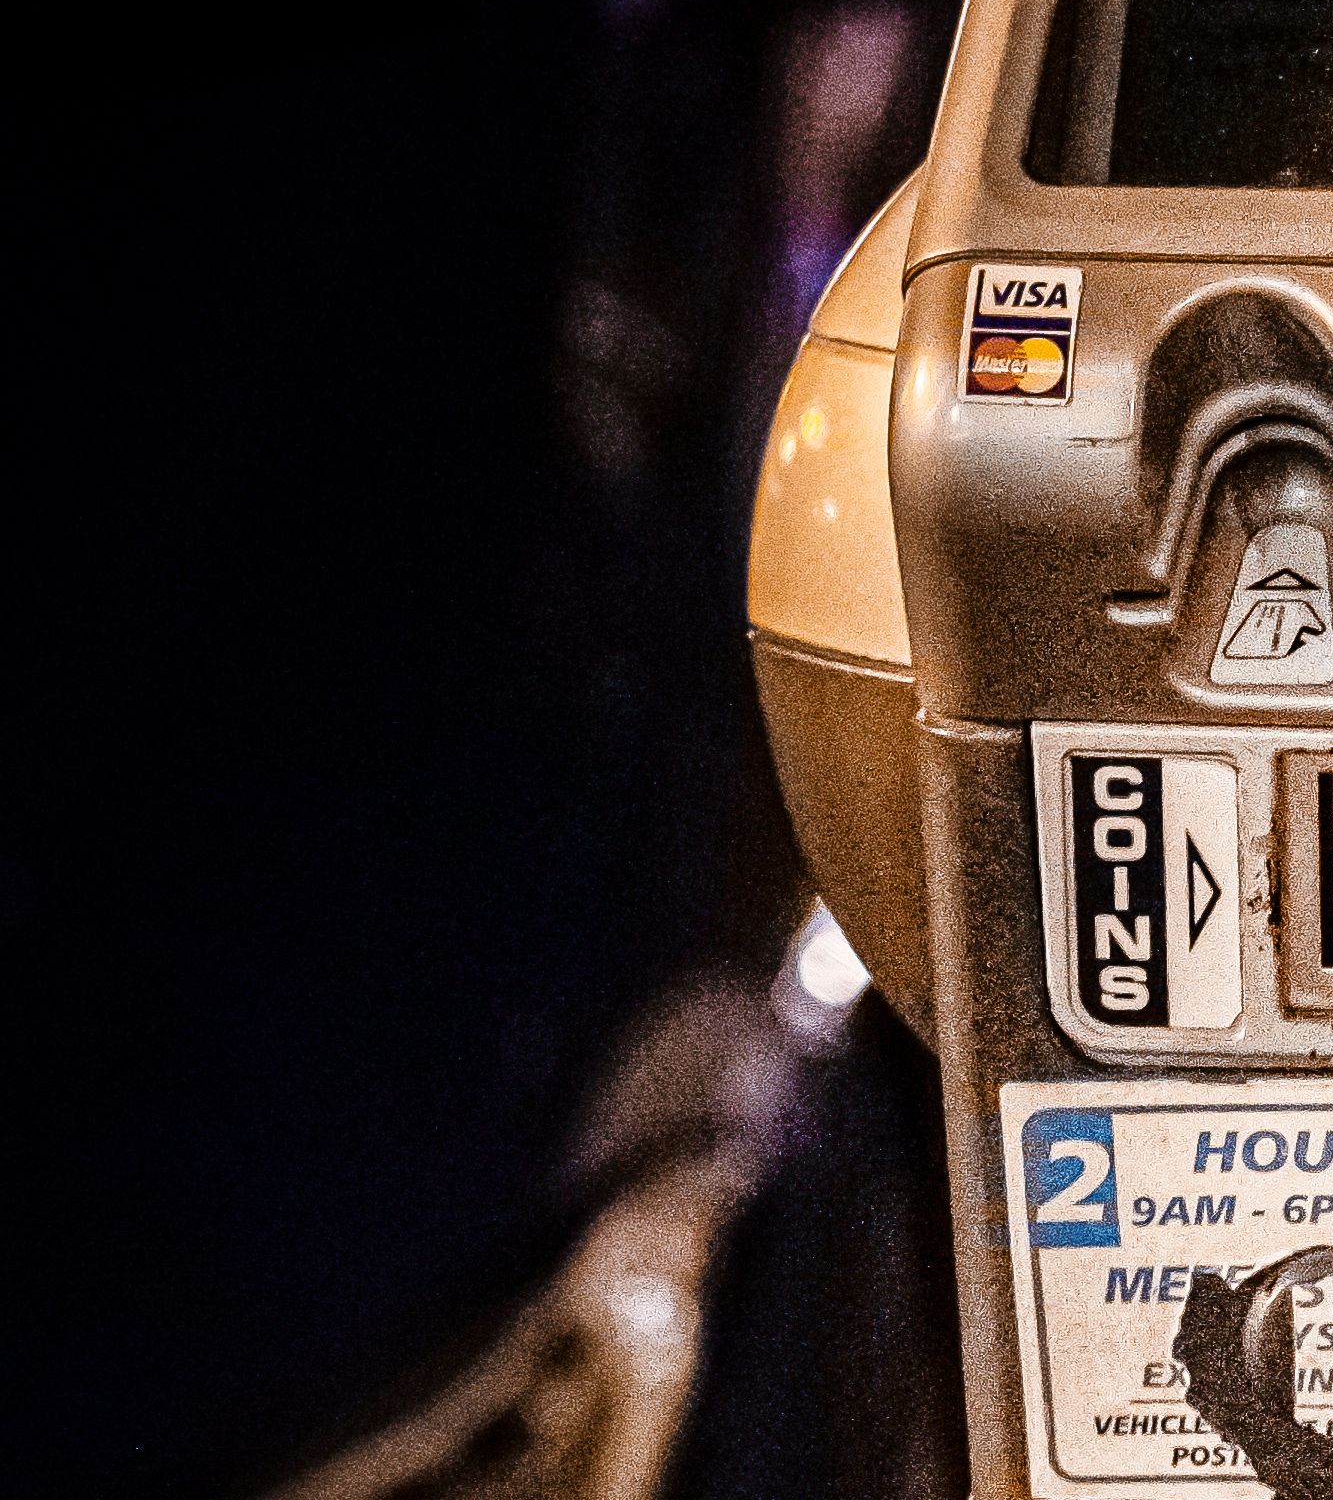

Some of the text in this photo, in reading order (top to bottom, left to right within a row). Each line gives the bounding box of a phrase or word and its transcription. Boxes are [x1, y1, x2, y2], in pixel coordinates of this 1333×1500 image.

[991, 280, 1068, 309] VISA
[1094, 764, 1152, 1011] COINS
[1037, 1138, 1110, 1223] 2
[1131, 1195, 1237, 1228] 9AM
